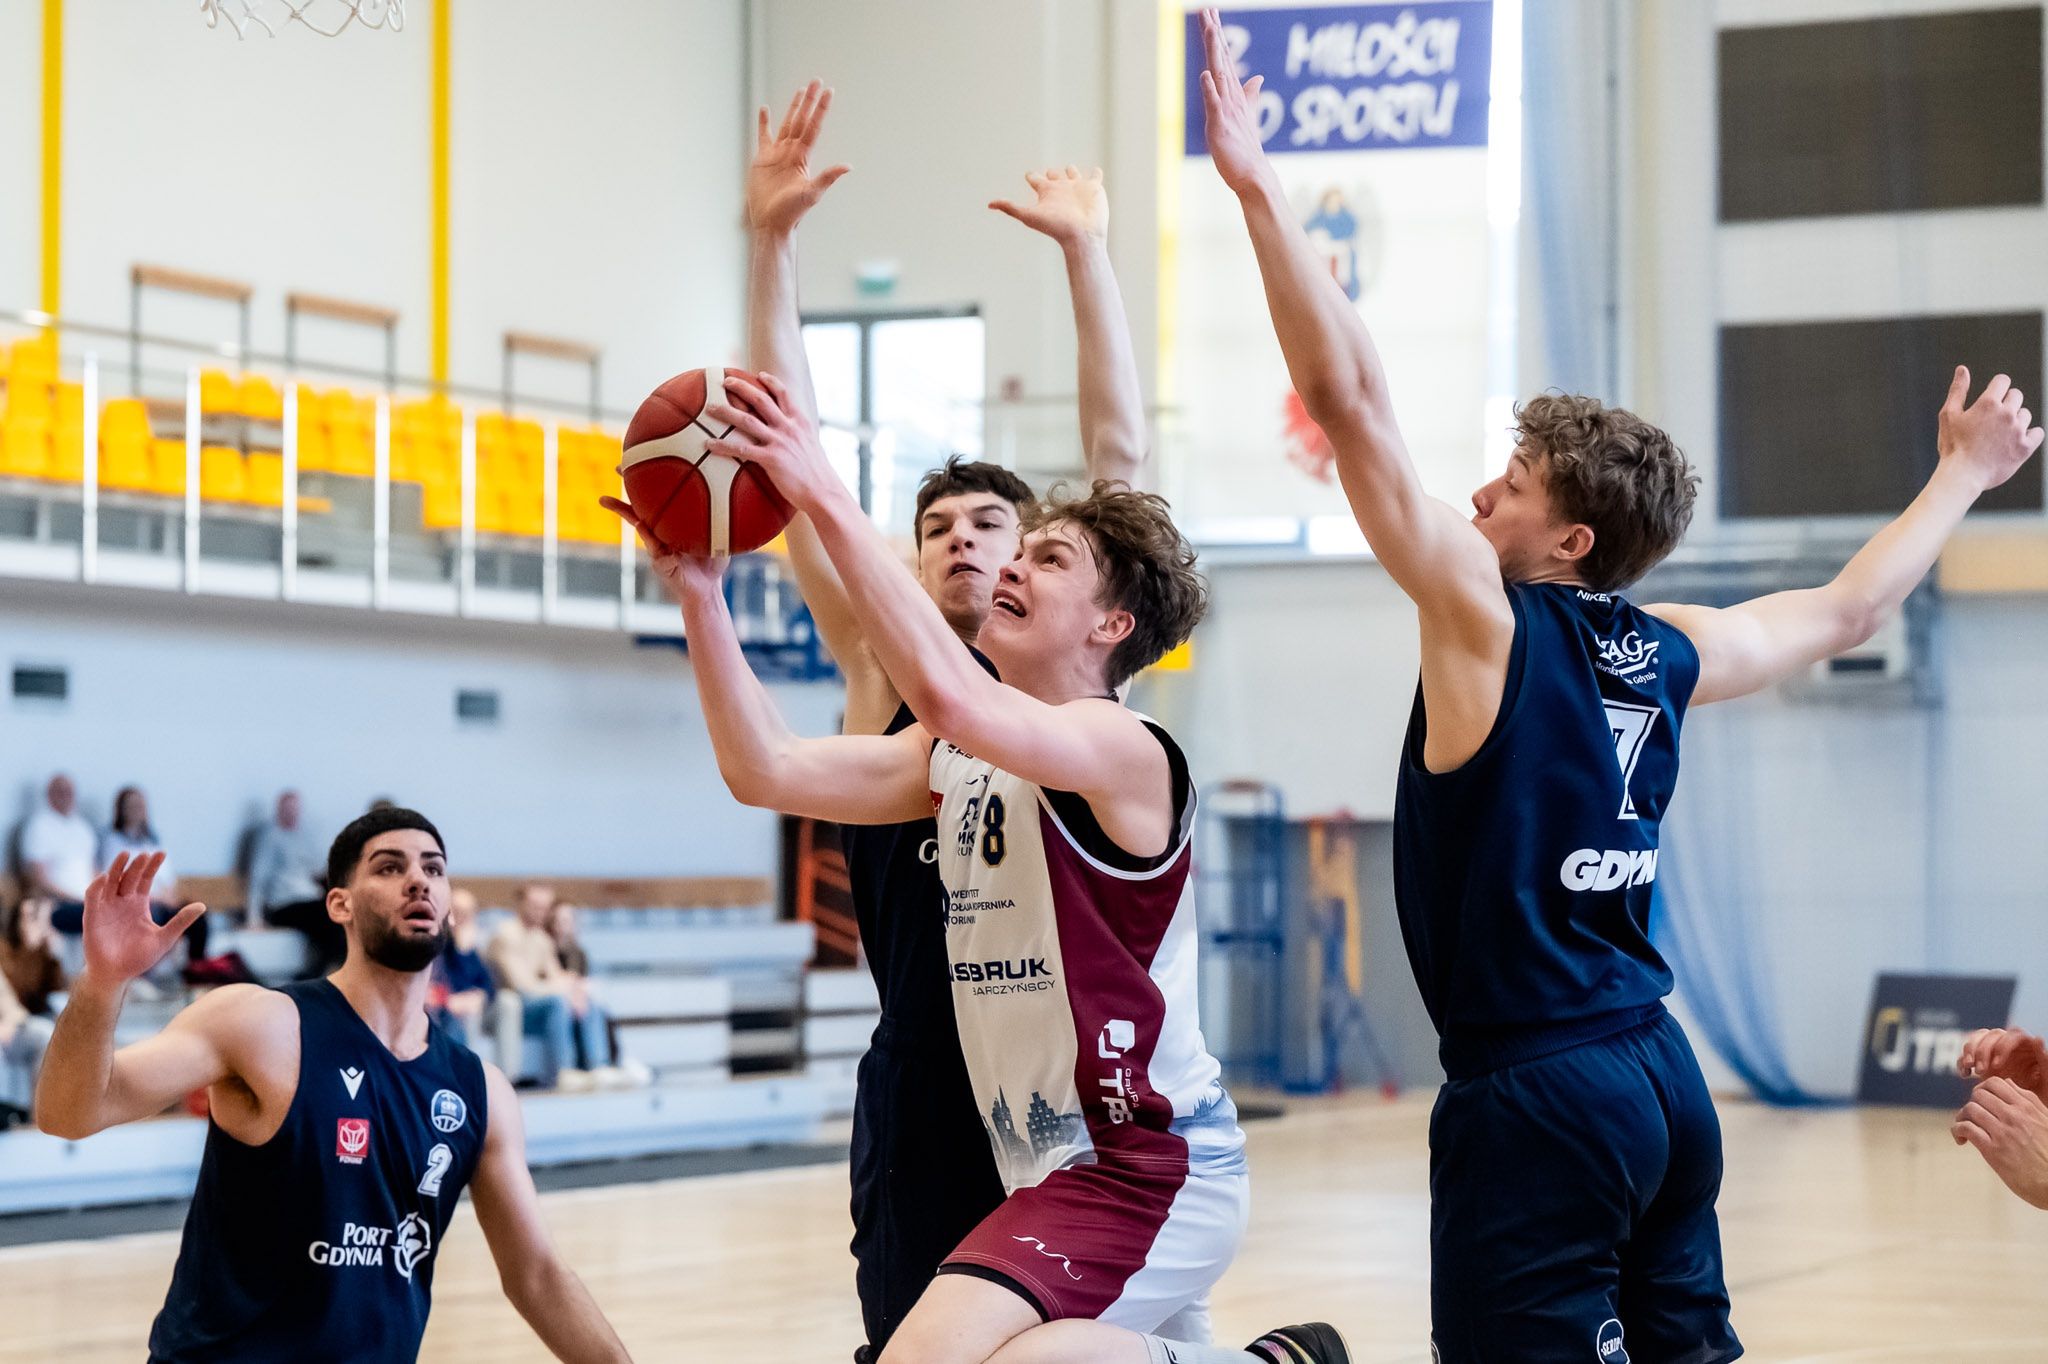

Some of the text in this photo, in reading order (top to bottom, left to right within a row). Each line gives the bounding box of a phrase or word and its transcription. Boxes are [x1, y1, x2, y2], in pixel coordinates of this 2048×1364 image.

[1602, 698, 1661, 820] 7
[950, 958, 1053, 983] SBRUK
[417, 1143, 453, 1197] 2
